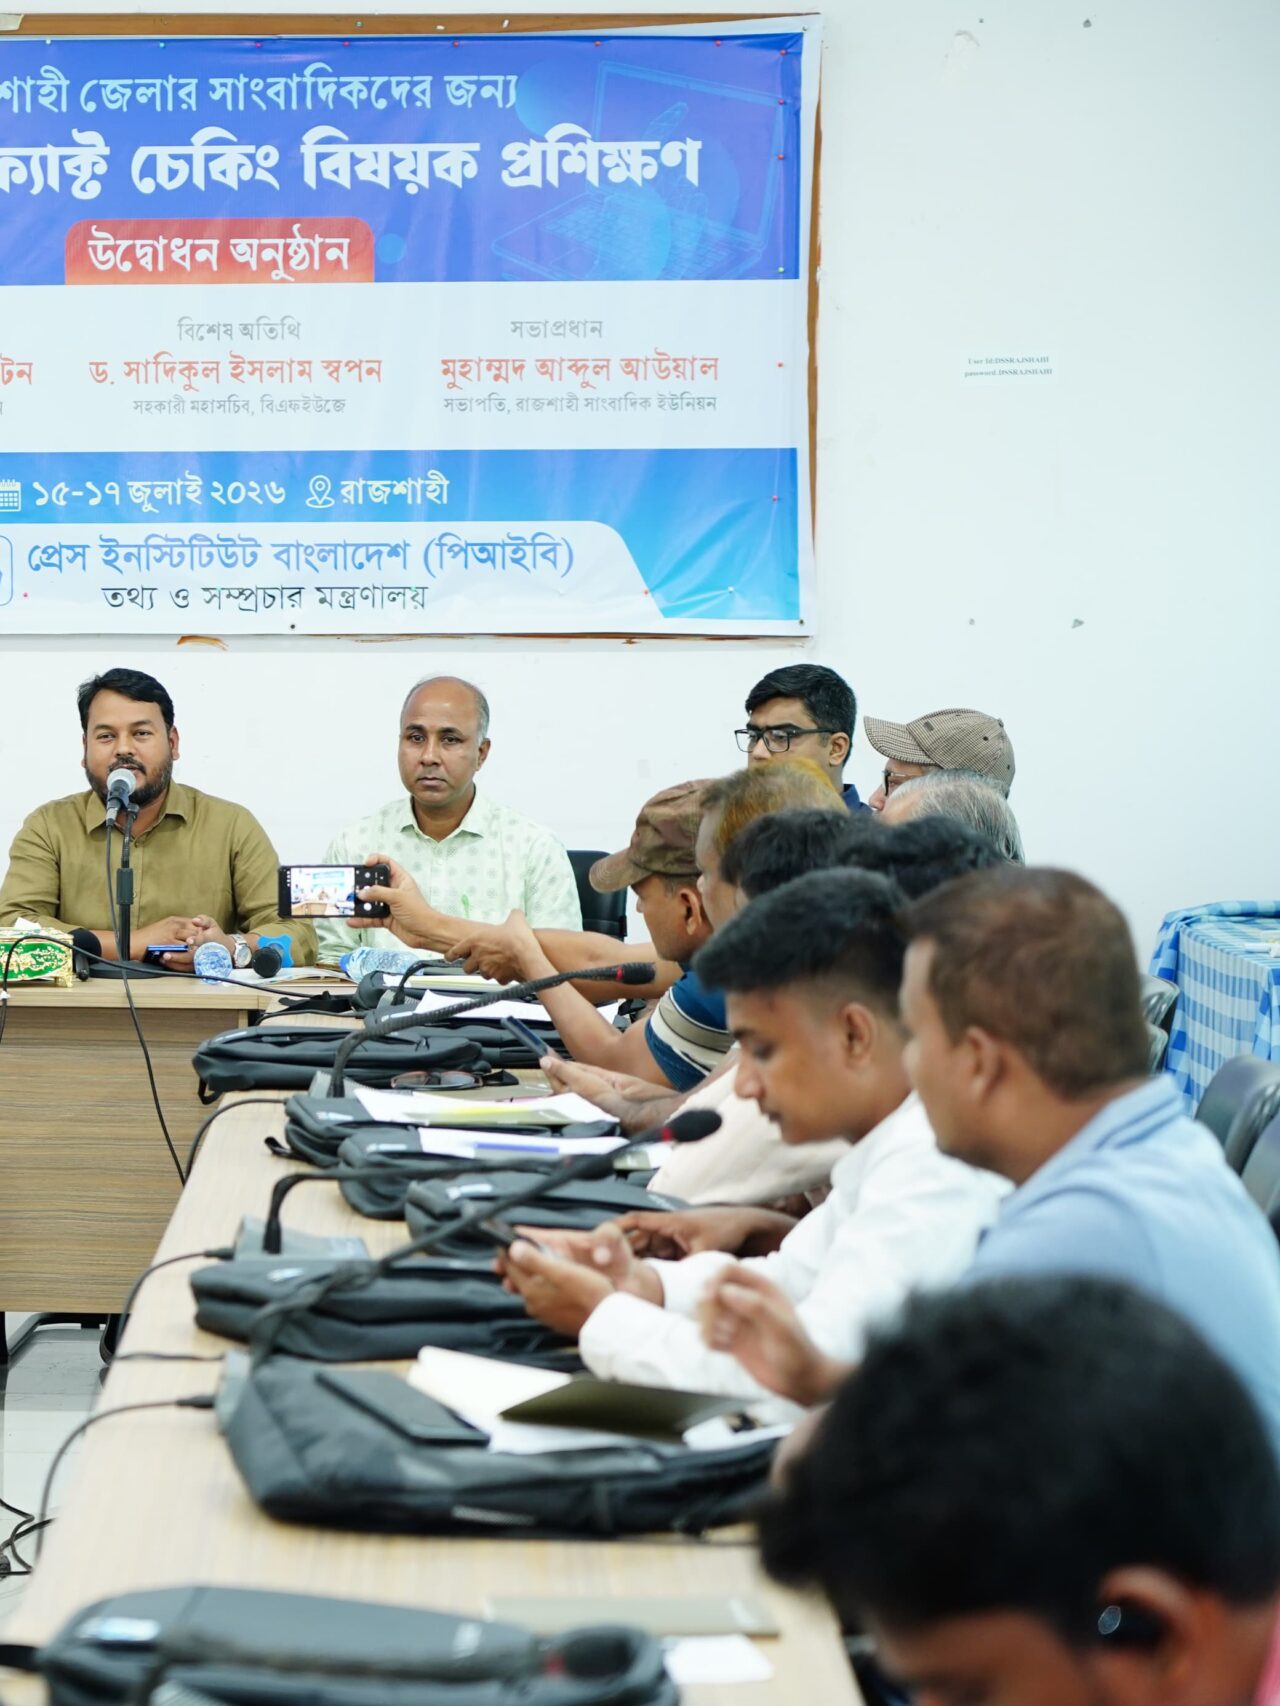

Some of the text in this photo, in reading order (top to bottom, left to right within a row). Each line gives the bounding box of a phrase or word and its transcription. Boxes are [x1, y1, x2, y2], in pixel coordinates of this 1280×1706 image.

[79, 74, 197, 112] জেলার
[209, 62, 431, 112] সাংবাদিকদের
[445, 74, 519, 110] জন্য
[131, 126, 280, 193] চেকিং
[301, 124, 480, 195] বিষয়ক
[501, 122, 702, 189] প্রশিক্ষণ
[88, 223, 351, 283] উদ্বোধন অনুষ্ঠান
[178, 315, 301, 342] বিশেষ অতিথি
[510, 319, 604, 339] সভাপ্রধান
[89, 350, 382, 392] ড. সাদিকুল ইসলাম স্বপন
[441, 347, 719, 390] মুহাম্মদ আব্দুল আউয়াল
[133, 393, 347, 417] সহকারী মহাসচিব, বিএফইউজে
[443, 391, 717, 415] সভাপতি, রাজশাহী সাংবাদিক ইউনিয়ন
[32, 469, 450, 514] ১৫-১৭ জুলাই ২০২৬ রাজশাহী
[28, 531, 574, 578] প্রেস ইনস্টিটিউট বাংলাদেশ (পিআইবি)
[101, 583, 429, 613] তথ্য ও সম্প্রচার মন্ত্রণালয়
